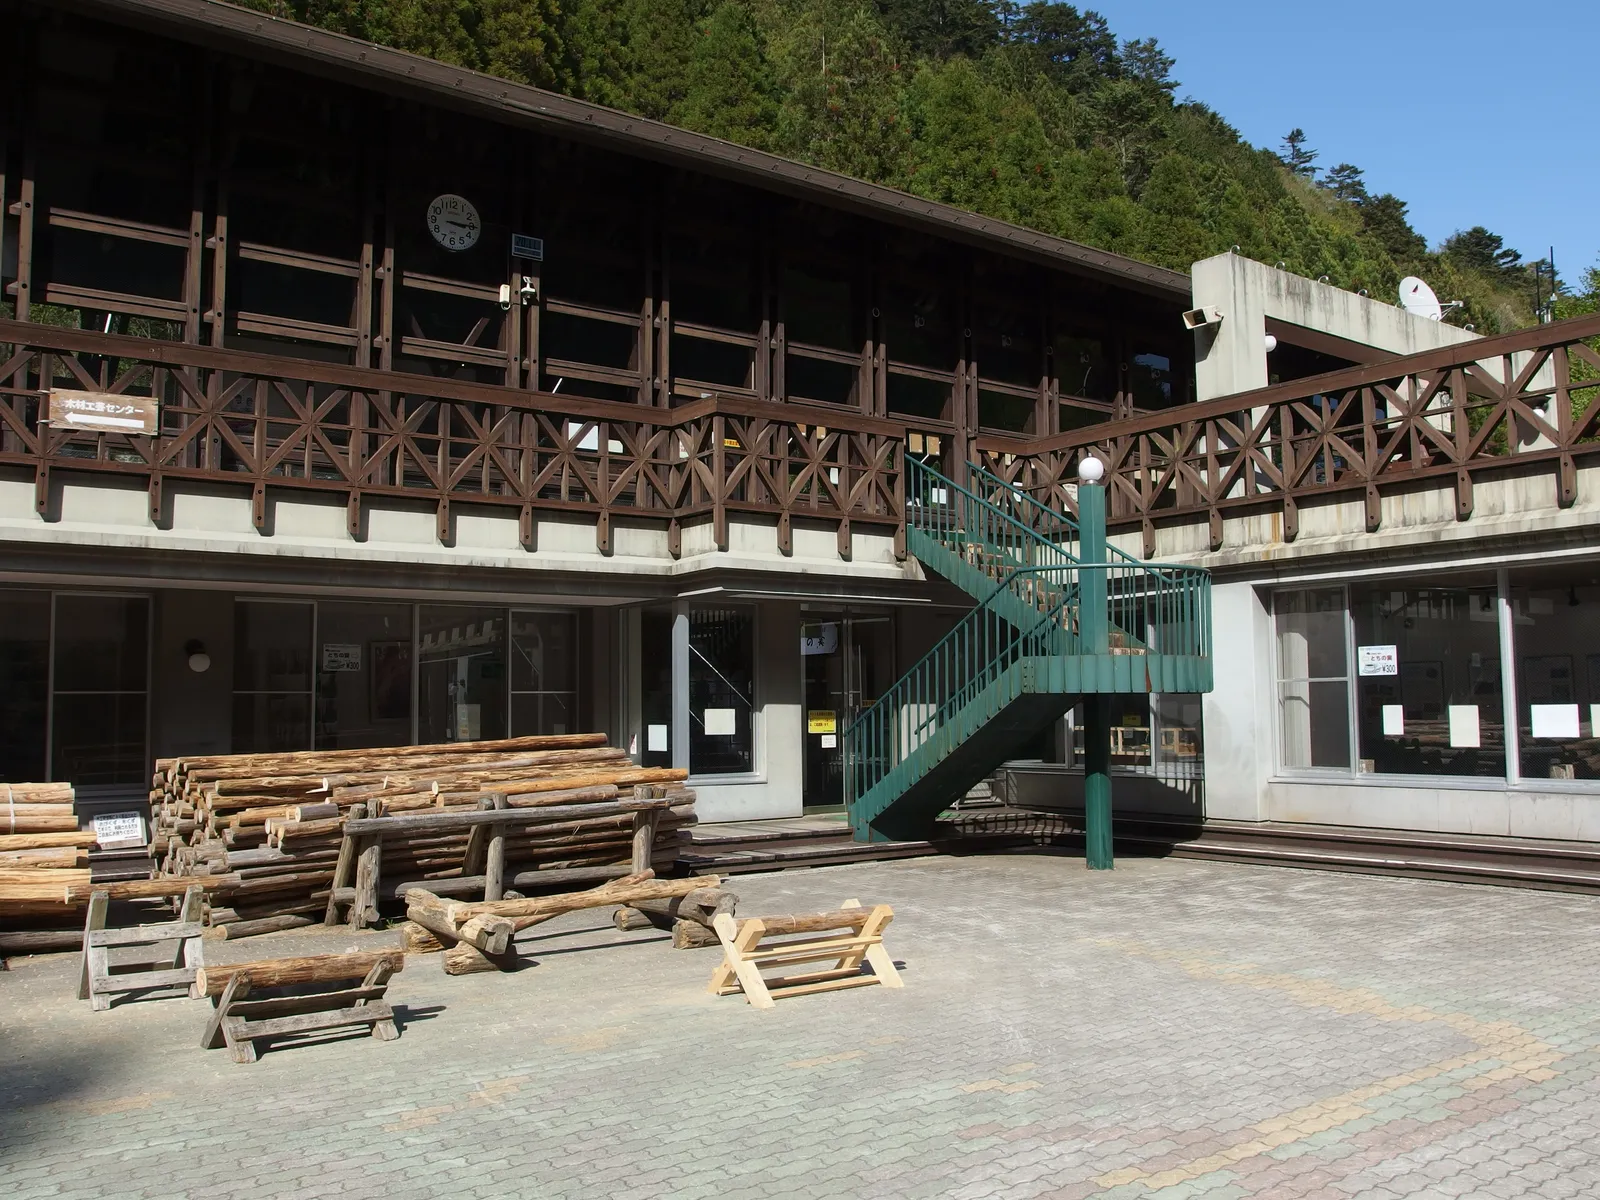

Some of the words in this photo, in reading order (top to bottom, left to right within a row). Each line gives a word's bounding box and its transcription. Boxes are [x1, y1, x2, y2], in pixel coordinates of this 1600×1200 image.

[65, 398, 144, 414] 木材工芸センター
